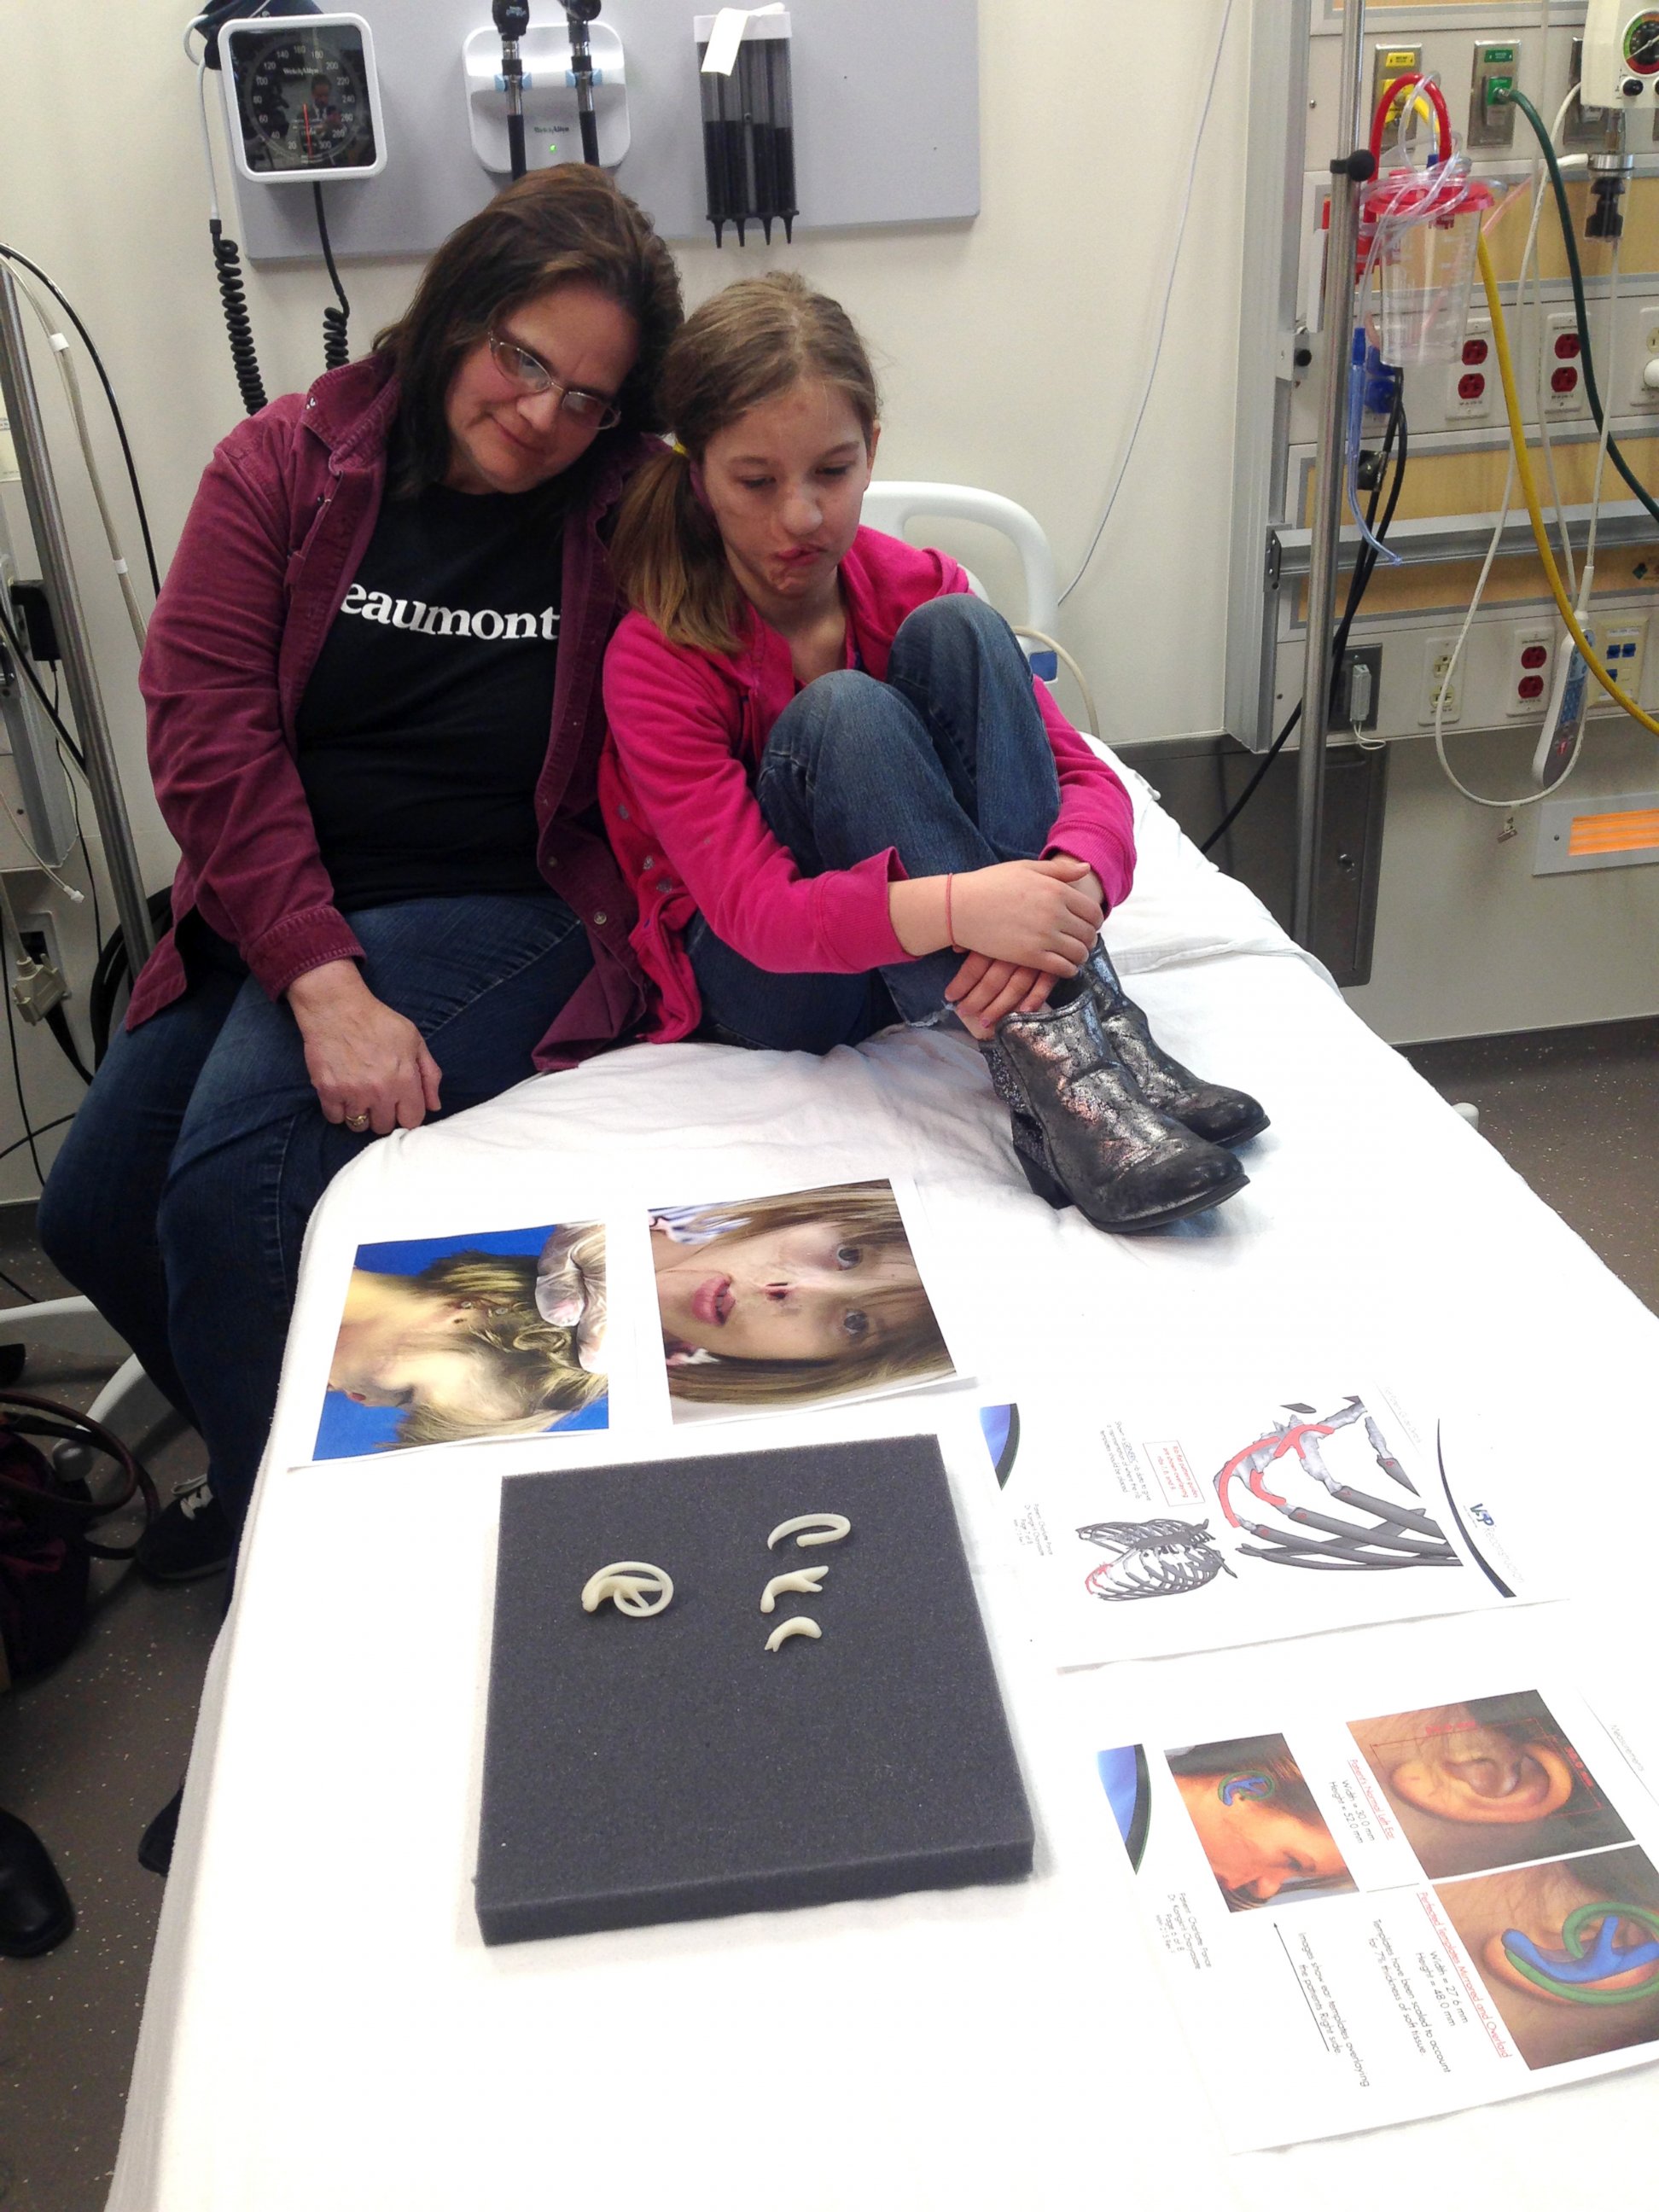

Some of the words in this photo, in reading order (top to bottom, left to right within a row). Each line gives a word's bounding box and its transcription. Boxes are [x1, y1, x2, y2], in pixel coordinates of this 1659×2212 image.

[264, 61, 276, 70] 120
[336, 77, 349, 85] 220
[1470, 1503, 1494, 1526] VSP
[1330, 1781, 1345, 1804] Height
[1343, 1813, 1359, 1829] 52.0
[1353, 1830, 1364, 1843] mm
[1342, 1779, 1356, 1802] Width
[1365, 1827, 1376, 1842] mm
[1350, 1759, 1367, 1785] Patient's
[1365, 1785, 1384, 1813] Normal
[1377, 1813, 1390, 1826] Left
[1384, 1826, 1395, 1839] Ear
[1368, 1937, 1378, 1949] for
[1299, 1964, 1308, 1977] the
[1304, 1979, 1323, 2011] patients
[1319, 2012, 1334, 2034] Right
[1373, 1918, 1394, 1956] Templates
[1391, 1957, 1405, 1977] have
[1400, 1978, 1415, 2000] been
[1411, 2001, 1432, 2028] scaled
[1424, 2029, 1433, 2039] to
[1429, 2040, 1451, 2073] account
[1381, 1965, 1401, 2001] thickness
[1416, 1952, 1434, 1978] Height
[1434, 1988, 1450, 2009] 48.0
[1444, 2011, 1456, 2027] mm
[1421, 1892, 1444, 1926] Perfected
[1438, 1928, 1460, 1965] Templates
[1458, 1965, 1483, 2002] Mirrored
[1476, 2003, 1493, 2020] and
[1486, 2021, 1512, 2058] Overlaid
[1429, 1951, 1447, 1976] Width
[1457, 2007, 1469, 2023] mm
[1298, 1932, 1314, 1960] Images
[1311, 1962, 1324, 1982] show
[1320, 1984, 1332, 1999] ear
[1329, 2000, 1349, 2040] templates
[1342, 2042, 1370, 2087] overlaying
[1398, 2002, 1412, 2011] of
[1403, 2013, 1418, 2029] soft
